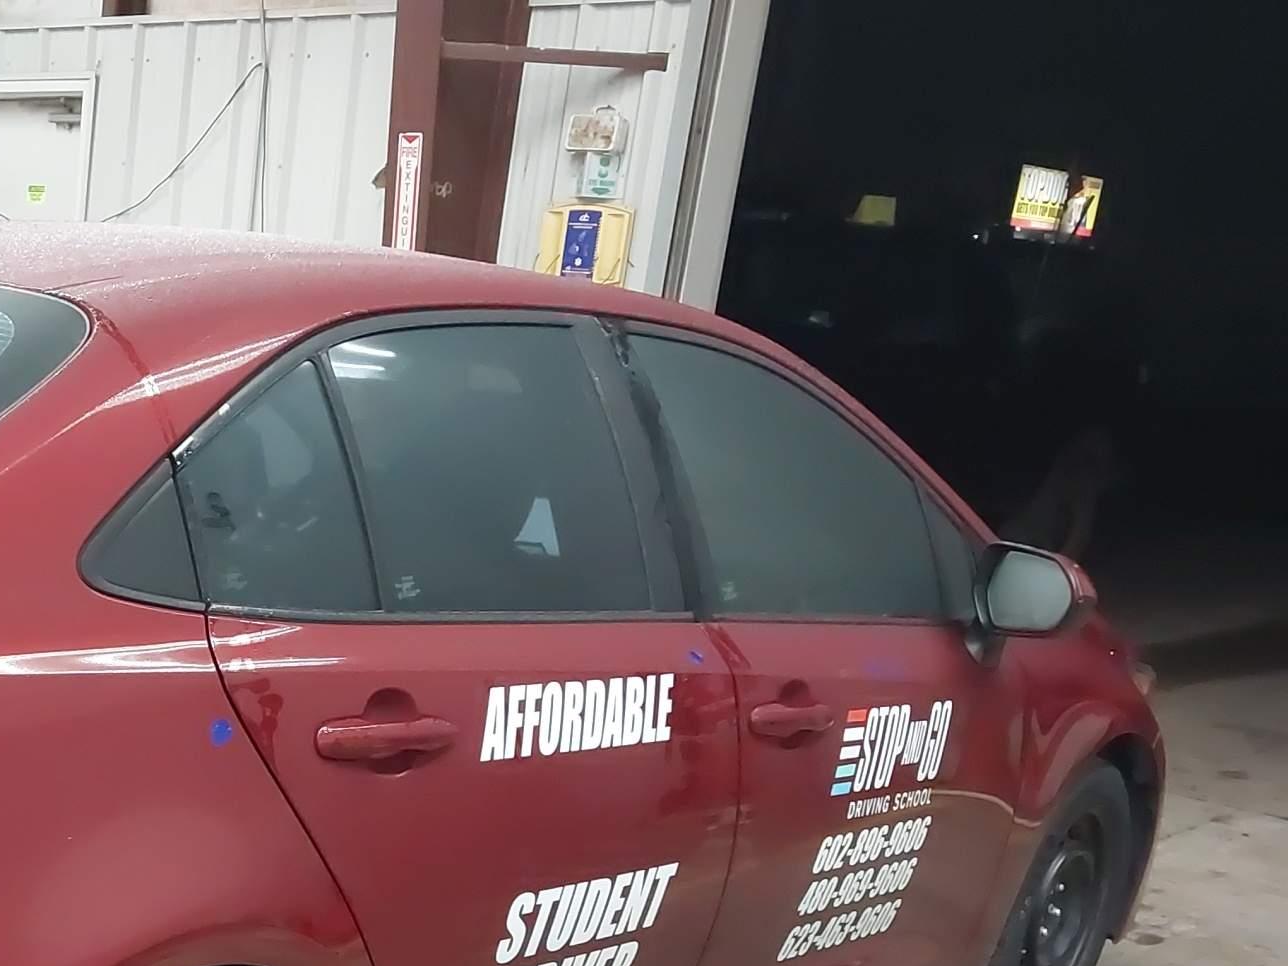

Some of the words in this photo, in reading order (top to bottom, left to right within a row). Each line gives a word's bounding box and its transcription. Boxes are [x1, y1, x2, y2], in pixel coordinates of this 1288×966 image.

[480, 673, 675, 762] AFFORDABLE
[853, 704, 911, 792] STOP
[900, 720, 928, 765] AND
[917, 700, 952, 782] GO
[847, 795, 890, 820] DRIVING
[892, 788, 932, 812] SCHOOL
[813, 816, 931, 874] 602-896-9606
[495, 862, 679, 964] STUDENT
[797, 857, 917, 916] 480-969-9606
[777, 899, 901, 961] 623-463-9606
